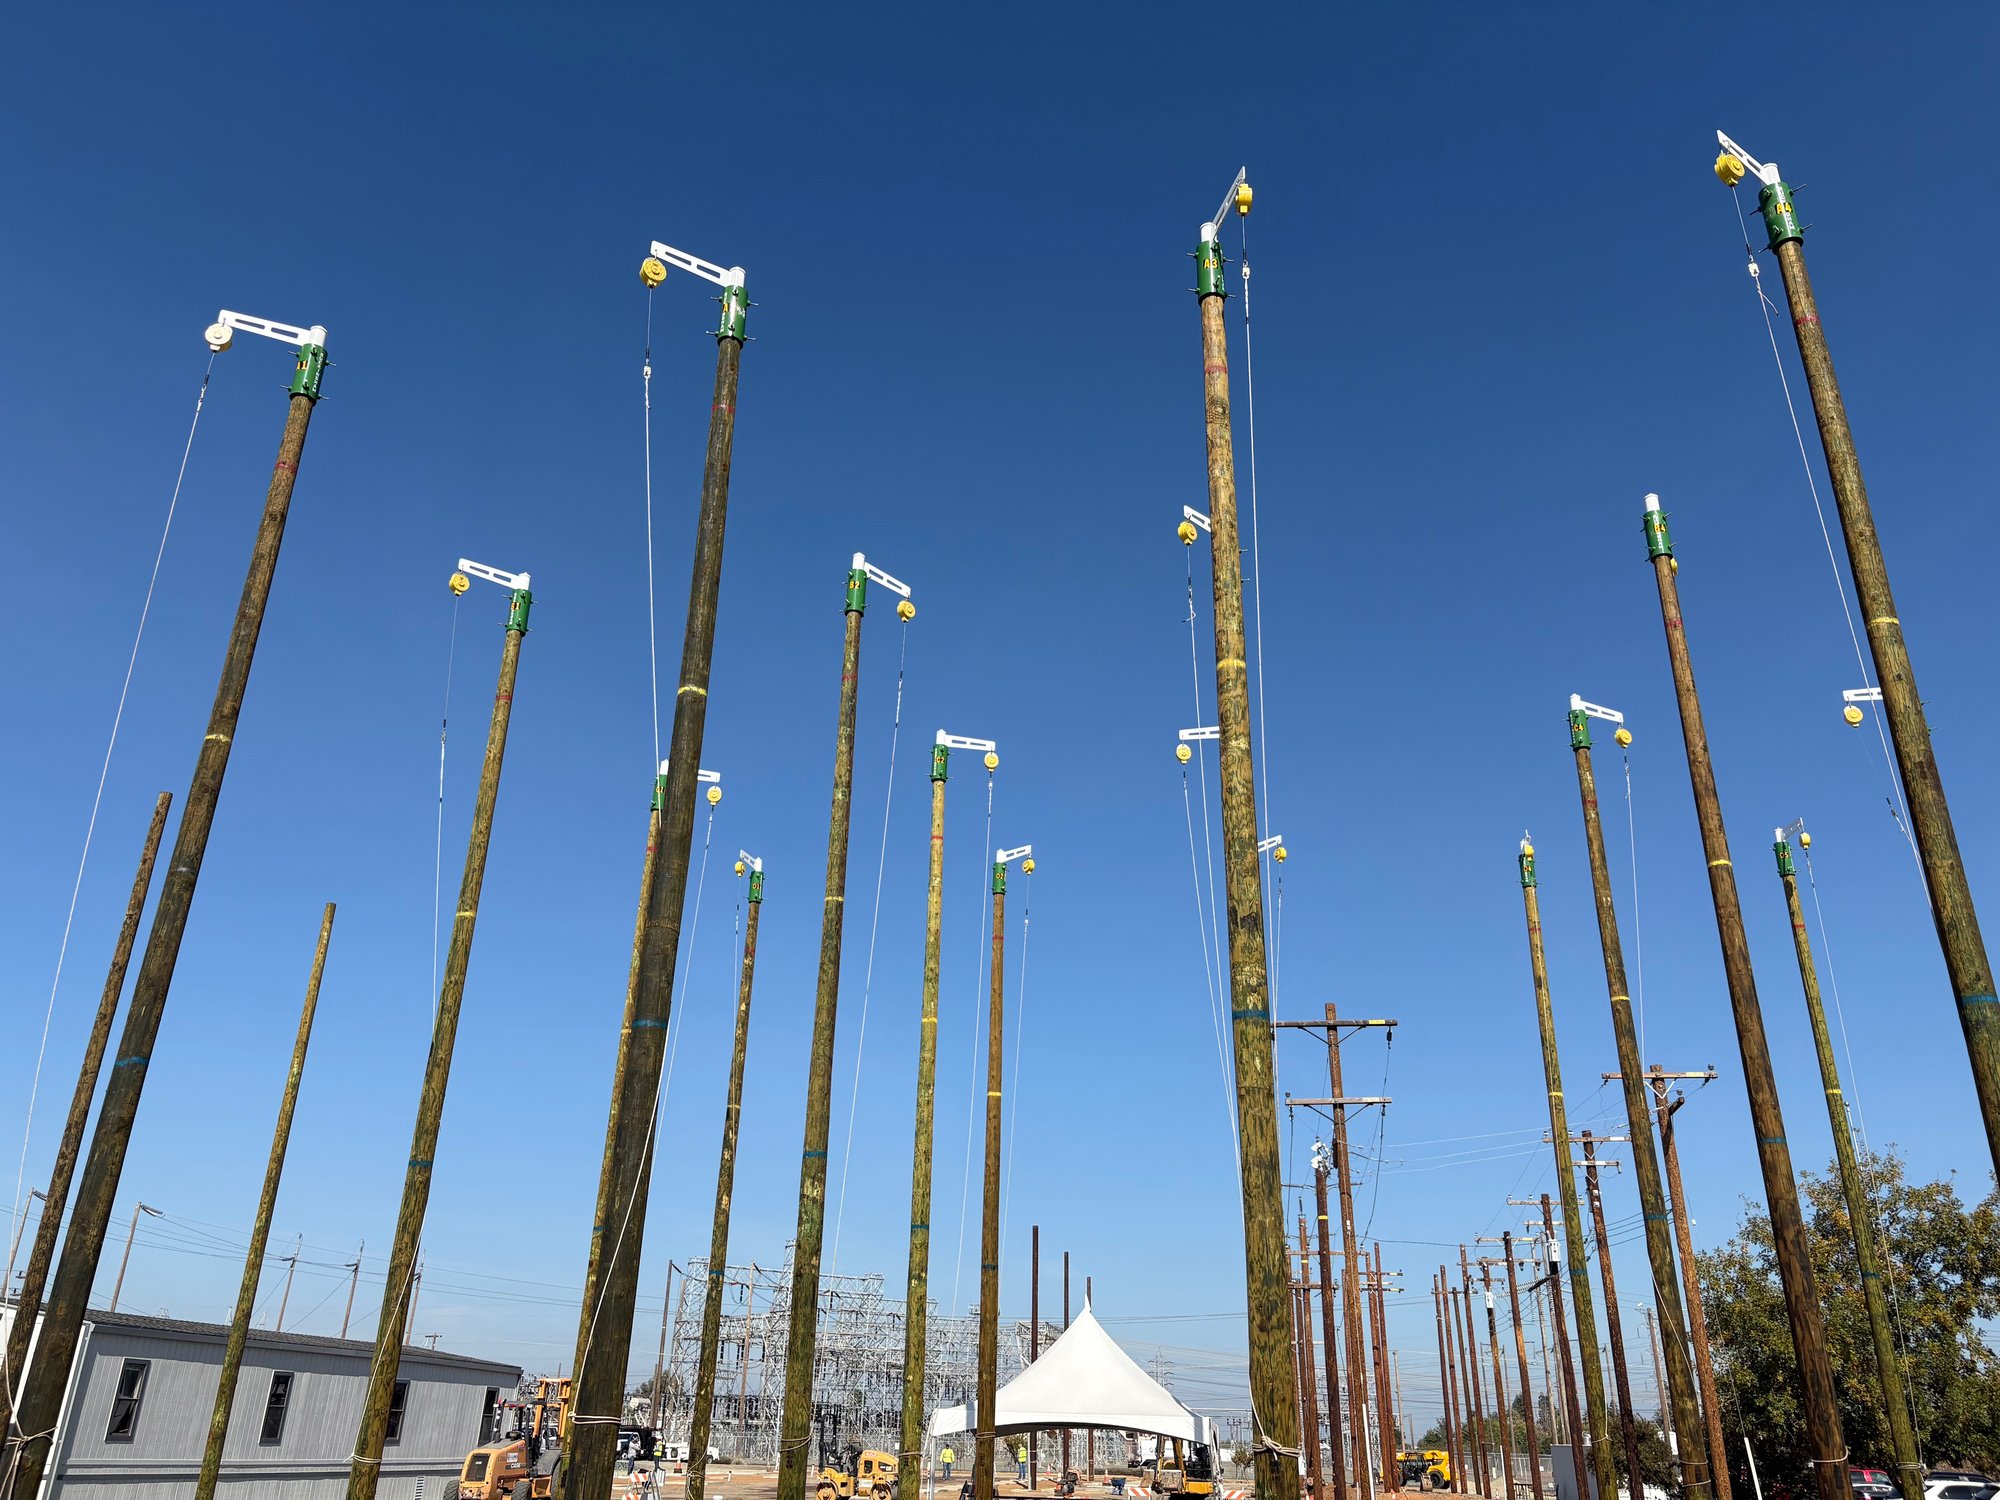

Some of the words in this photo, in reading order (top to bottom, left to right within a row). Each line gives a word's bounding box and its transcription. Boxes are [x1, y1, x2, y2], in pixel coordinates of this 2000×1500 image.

[1775, 202, 1792, 215] A4
[1203, 258, 1218, 269] A3
[1654, 523, 1666, 533] B4
[849, 580, 860, 589] B2
[1573, 723, 1584, 731] C4
[936, 756, 945, 764] C2
